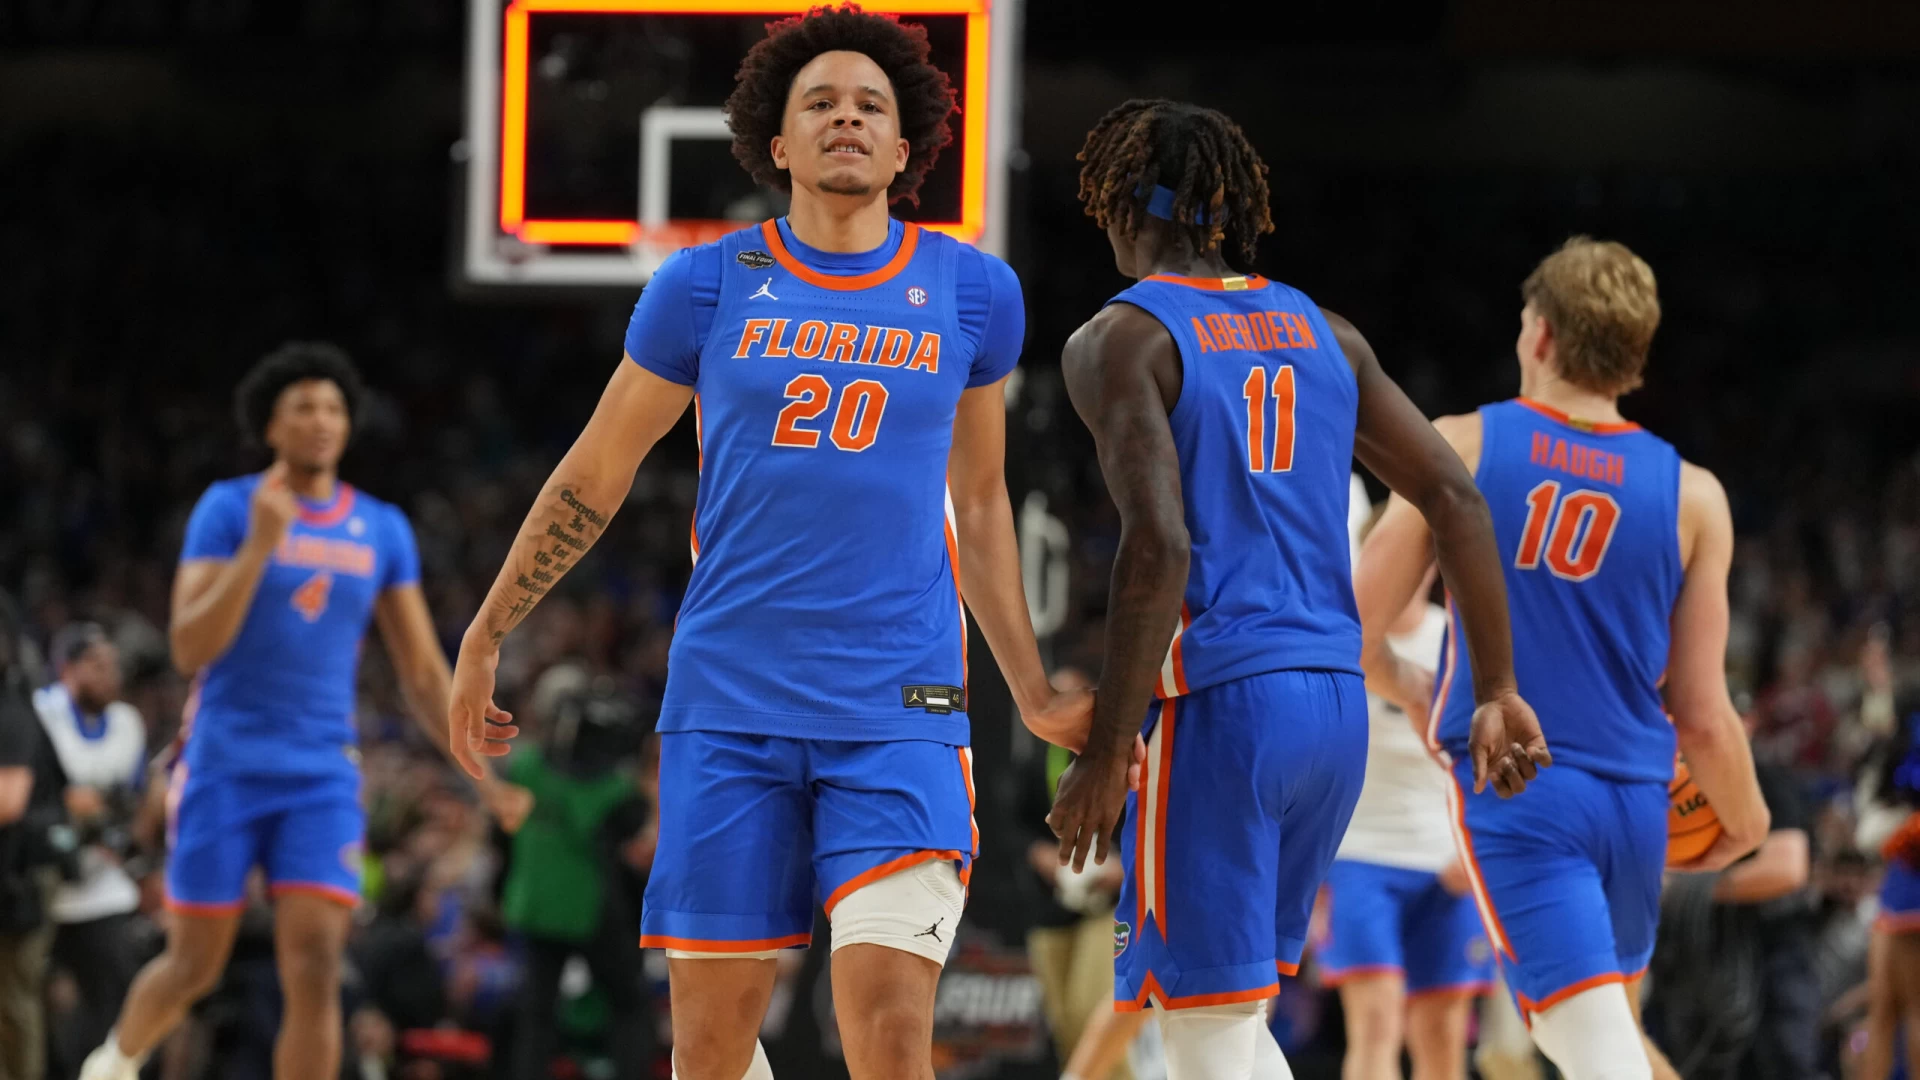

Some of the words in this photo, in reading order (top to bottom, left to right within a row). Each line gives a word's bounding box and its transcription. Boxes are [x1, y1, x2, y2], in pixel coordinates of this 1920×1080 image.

[739, 253, 756, 262] FINAL
[756, 256, 773, 264] FOUR
[908, 288, 926, 304] SEC
[731, 318, 941, 373] FLORIDA
[1191, 311, 1318, 353] ABERDEEN
[771, 374, 889, 453] 20
[1243, 365, 1295, 473] 11
[1531, 431, 1624, 486] HAUGH
[1515, 479, 1621, 582] 10
[291, 567, 334, 623] 4
